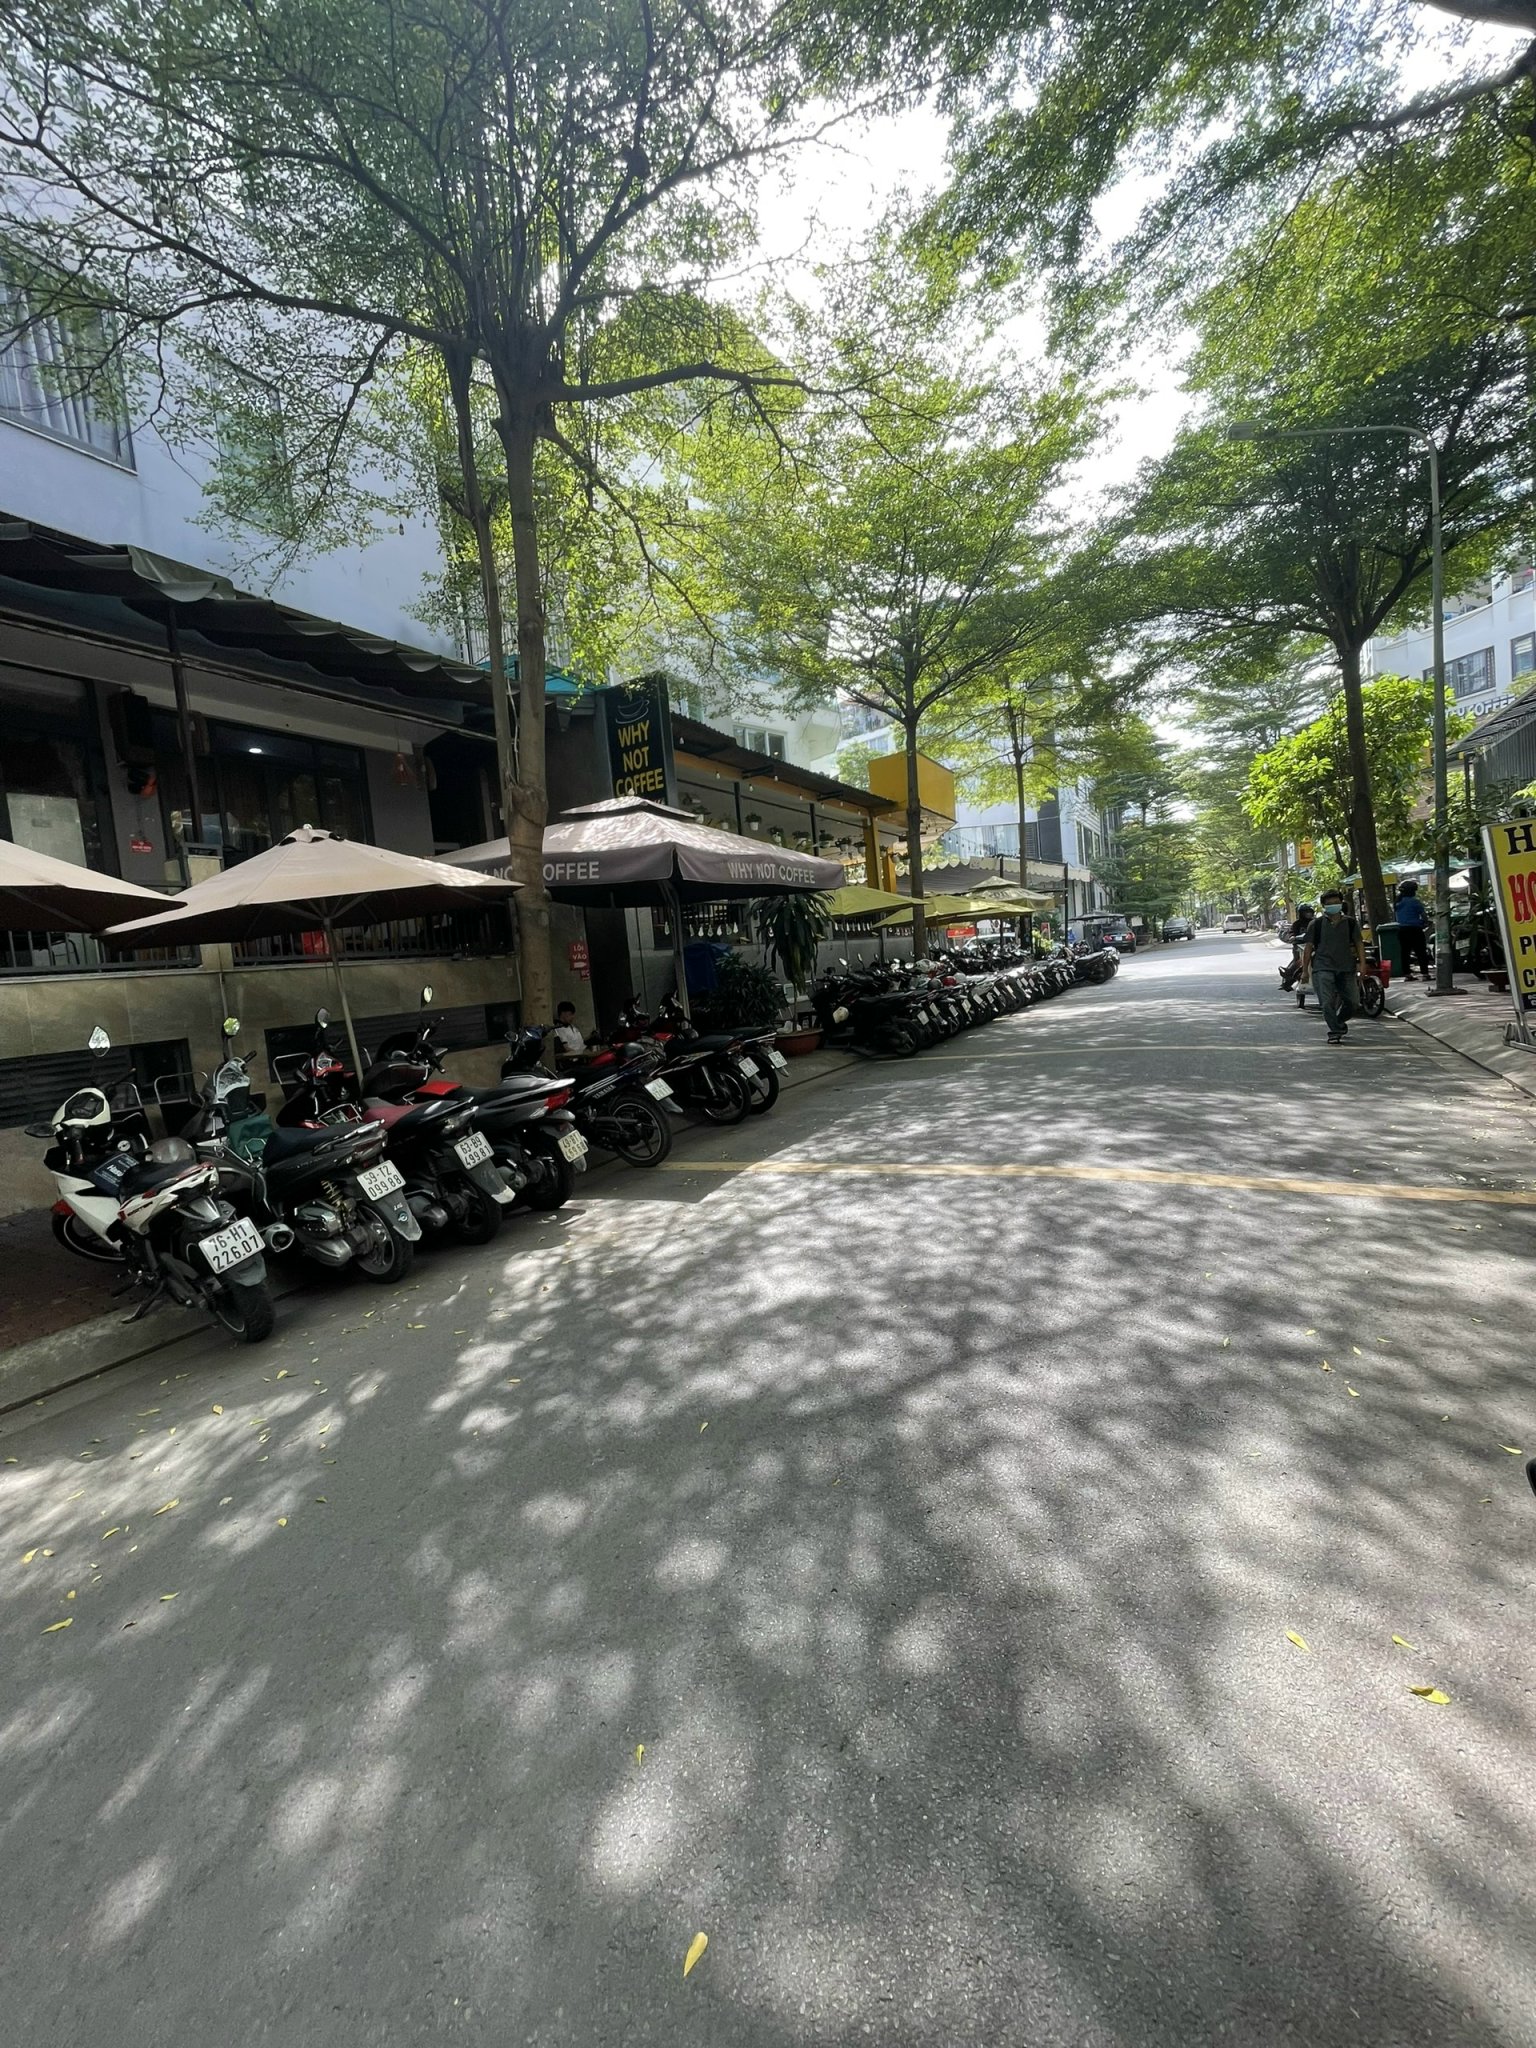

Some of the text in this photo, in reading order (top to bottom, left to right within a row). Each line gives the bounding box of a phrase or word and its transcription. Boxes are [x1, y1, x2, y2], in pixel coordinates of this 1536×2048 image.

[618, 719, 650, 748] WHY
[623, 746, 649, 773] NOT
[615, 767, 664, 798] COFFEE
[542, 861, 600, 881] OFFEE
[727, 862, 816, 884] WHY NOT COFFEE
[460, 1136, 482, 1154] 63-B9
[363, 1165, 392, 1185] 59-T2
[208, 1224, 247, 1252] 76-H1
[212, 1234, 259, 1271] 226.07
